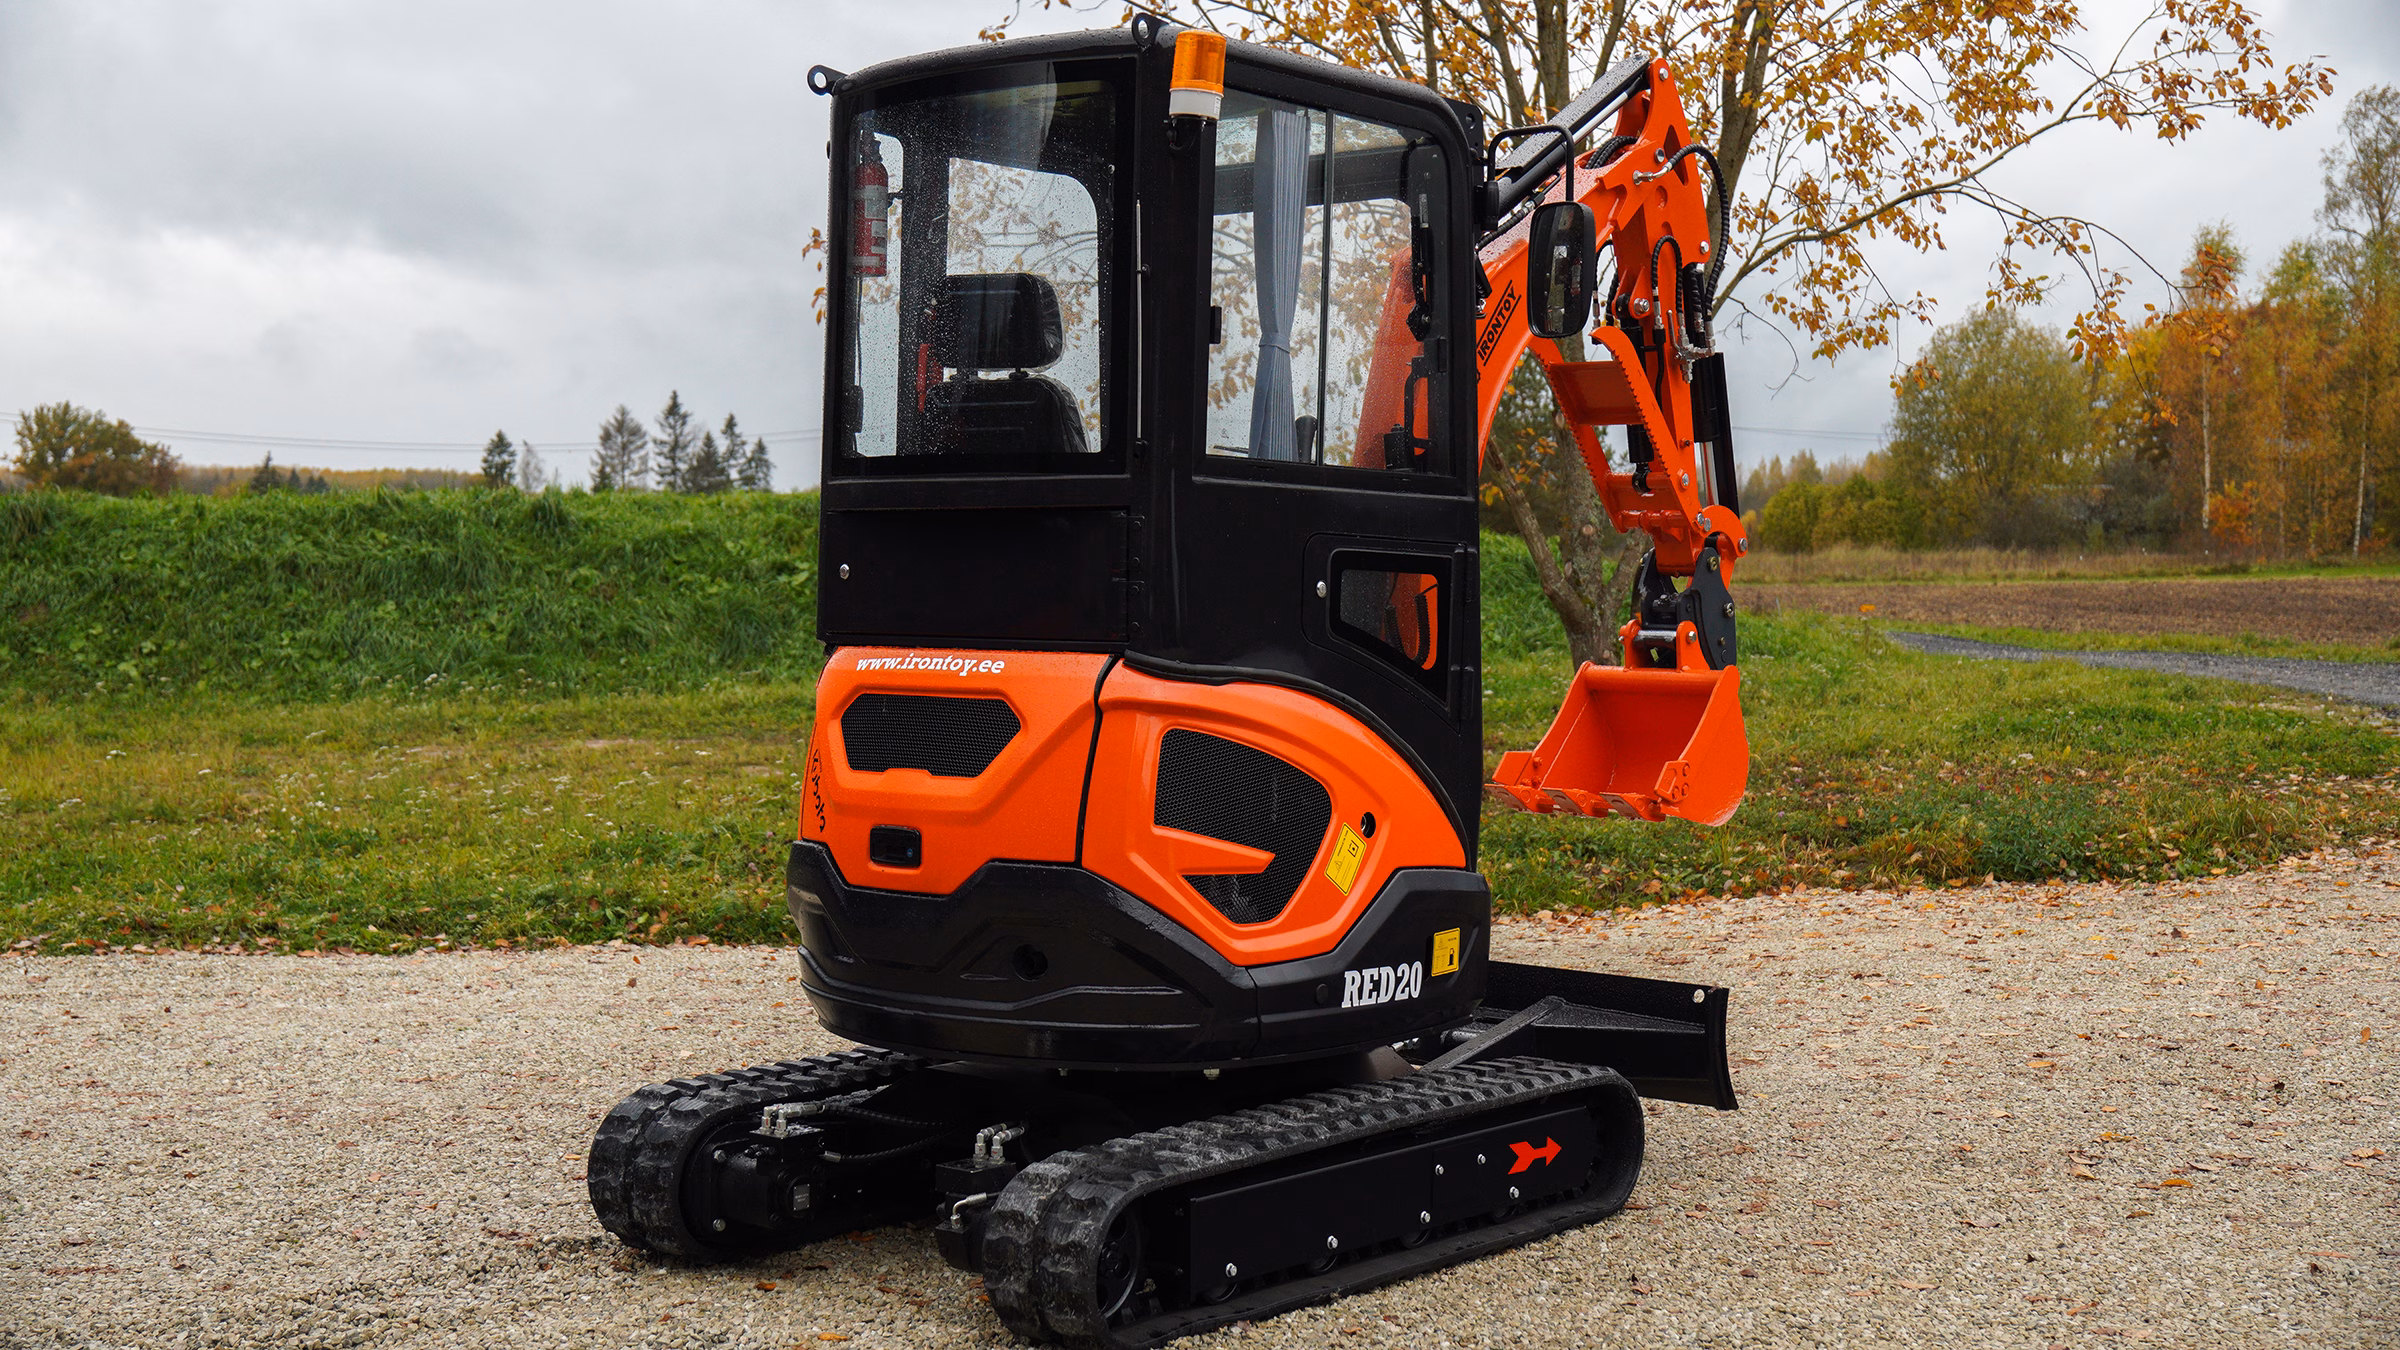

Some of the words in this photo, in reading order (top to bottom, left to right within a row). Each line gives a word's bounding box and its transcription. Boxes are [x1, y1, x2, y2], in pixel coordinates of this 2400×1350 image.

[1477, 286, 1516, 361] IRONTOY
[856, 652, 1005, 677] www.irontoy.ee
[1341, 960, 1423, 1008] RED20
